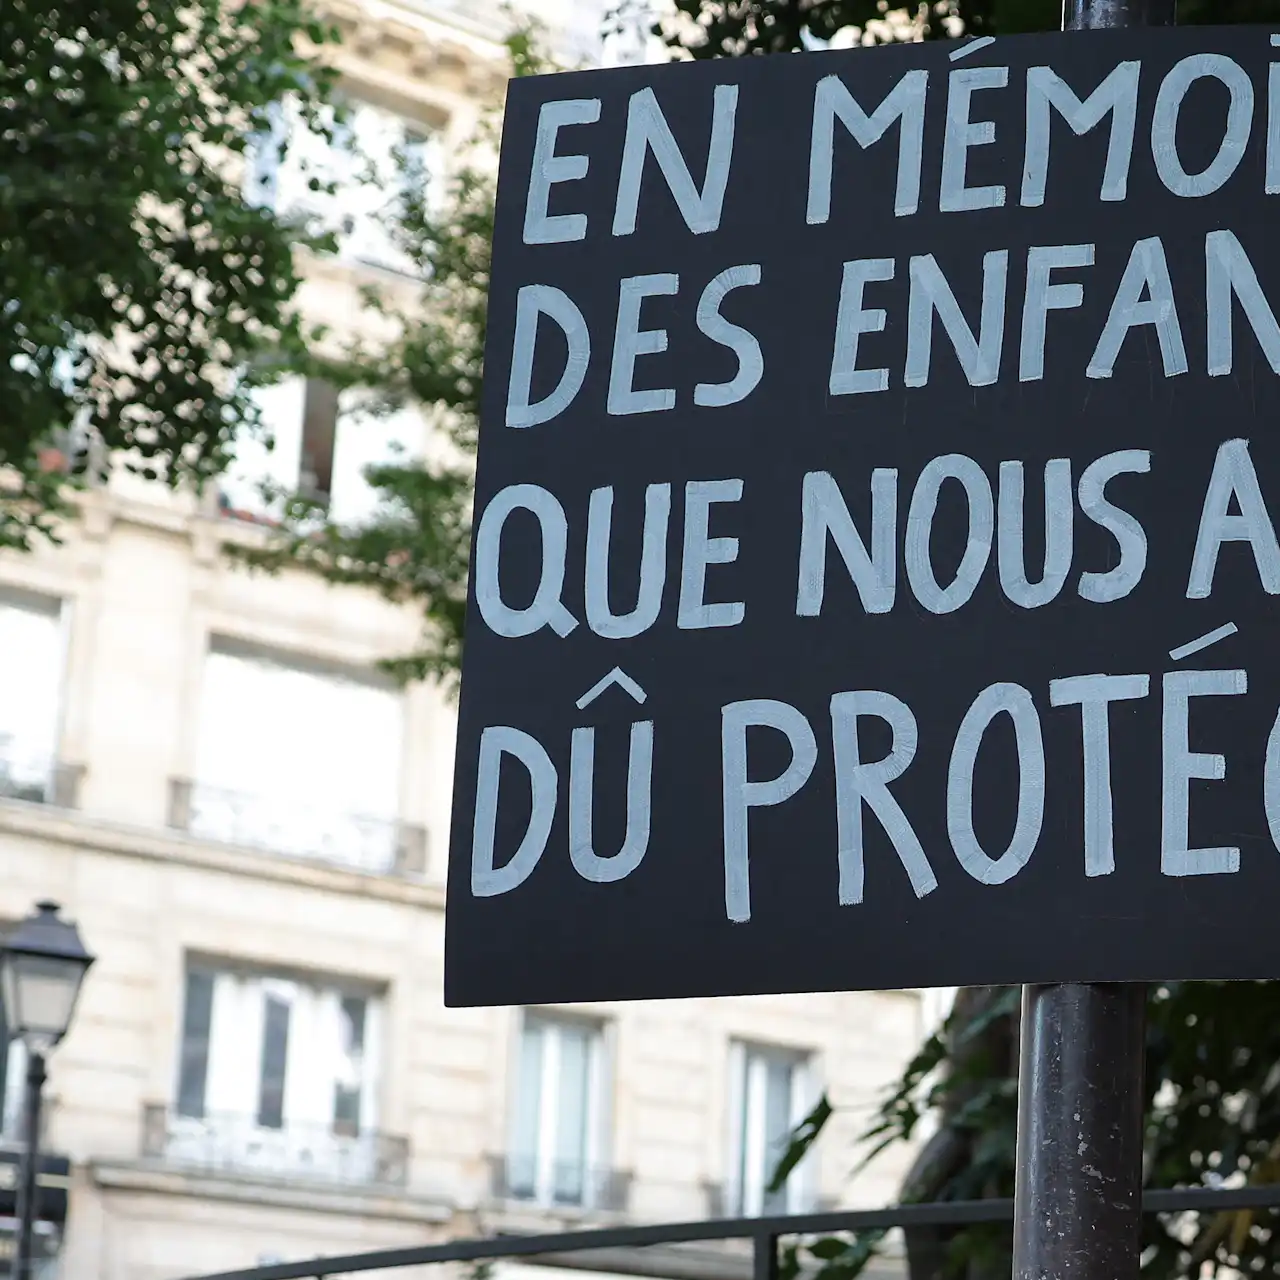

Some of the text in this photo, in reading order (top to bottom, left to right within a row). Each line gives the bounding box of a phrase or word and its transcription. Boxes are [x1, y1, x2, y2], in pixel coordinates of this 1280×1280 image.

[522, 83, 739, 245] EN
[505, 263, 764, 429] DES
[477, 478, 746, 640] QUE
[796, 448, 1152, 616] NOUS
[470, 665, 655, 898] DÛ
